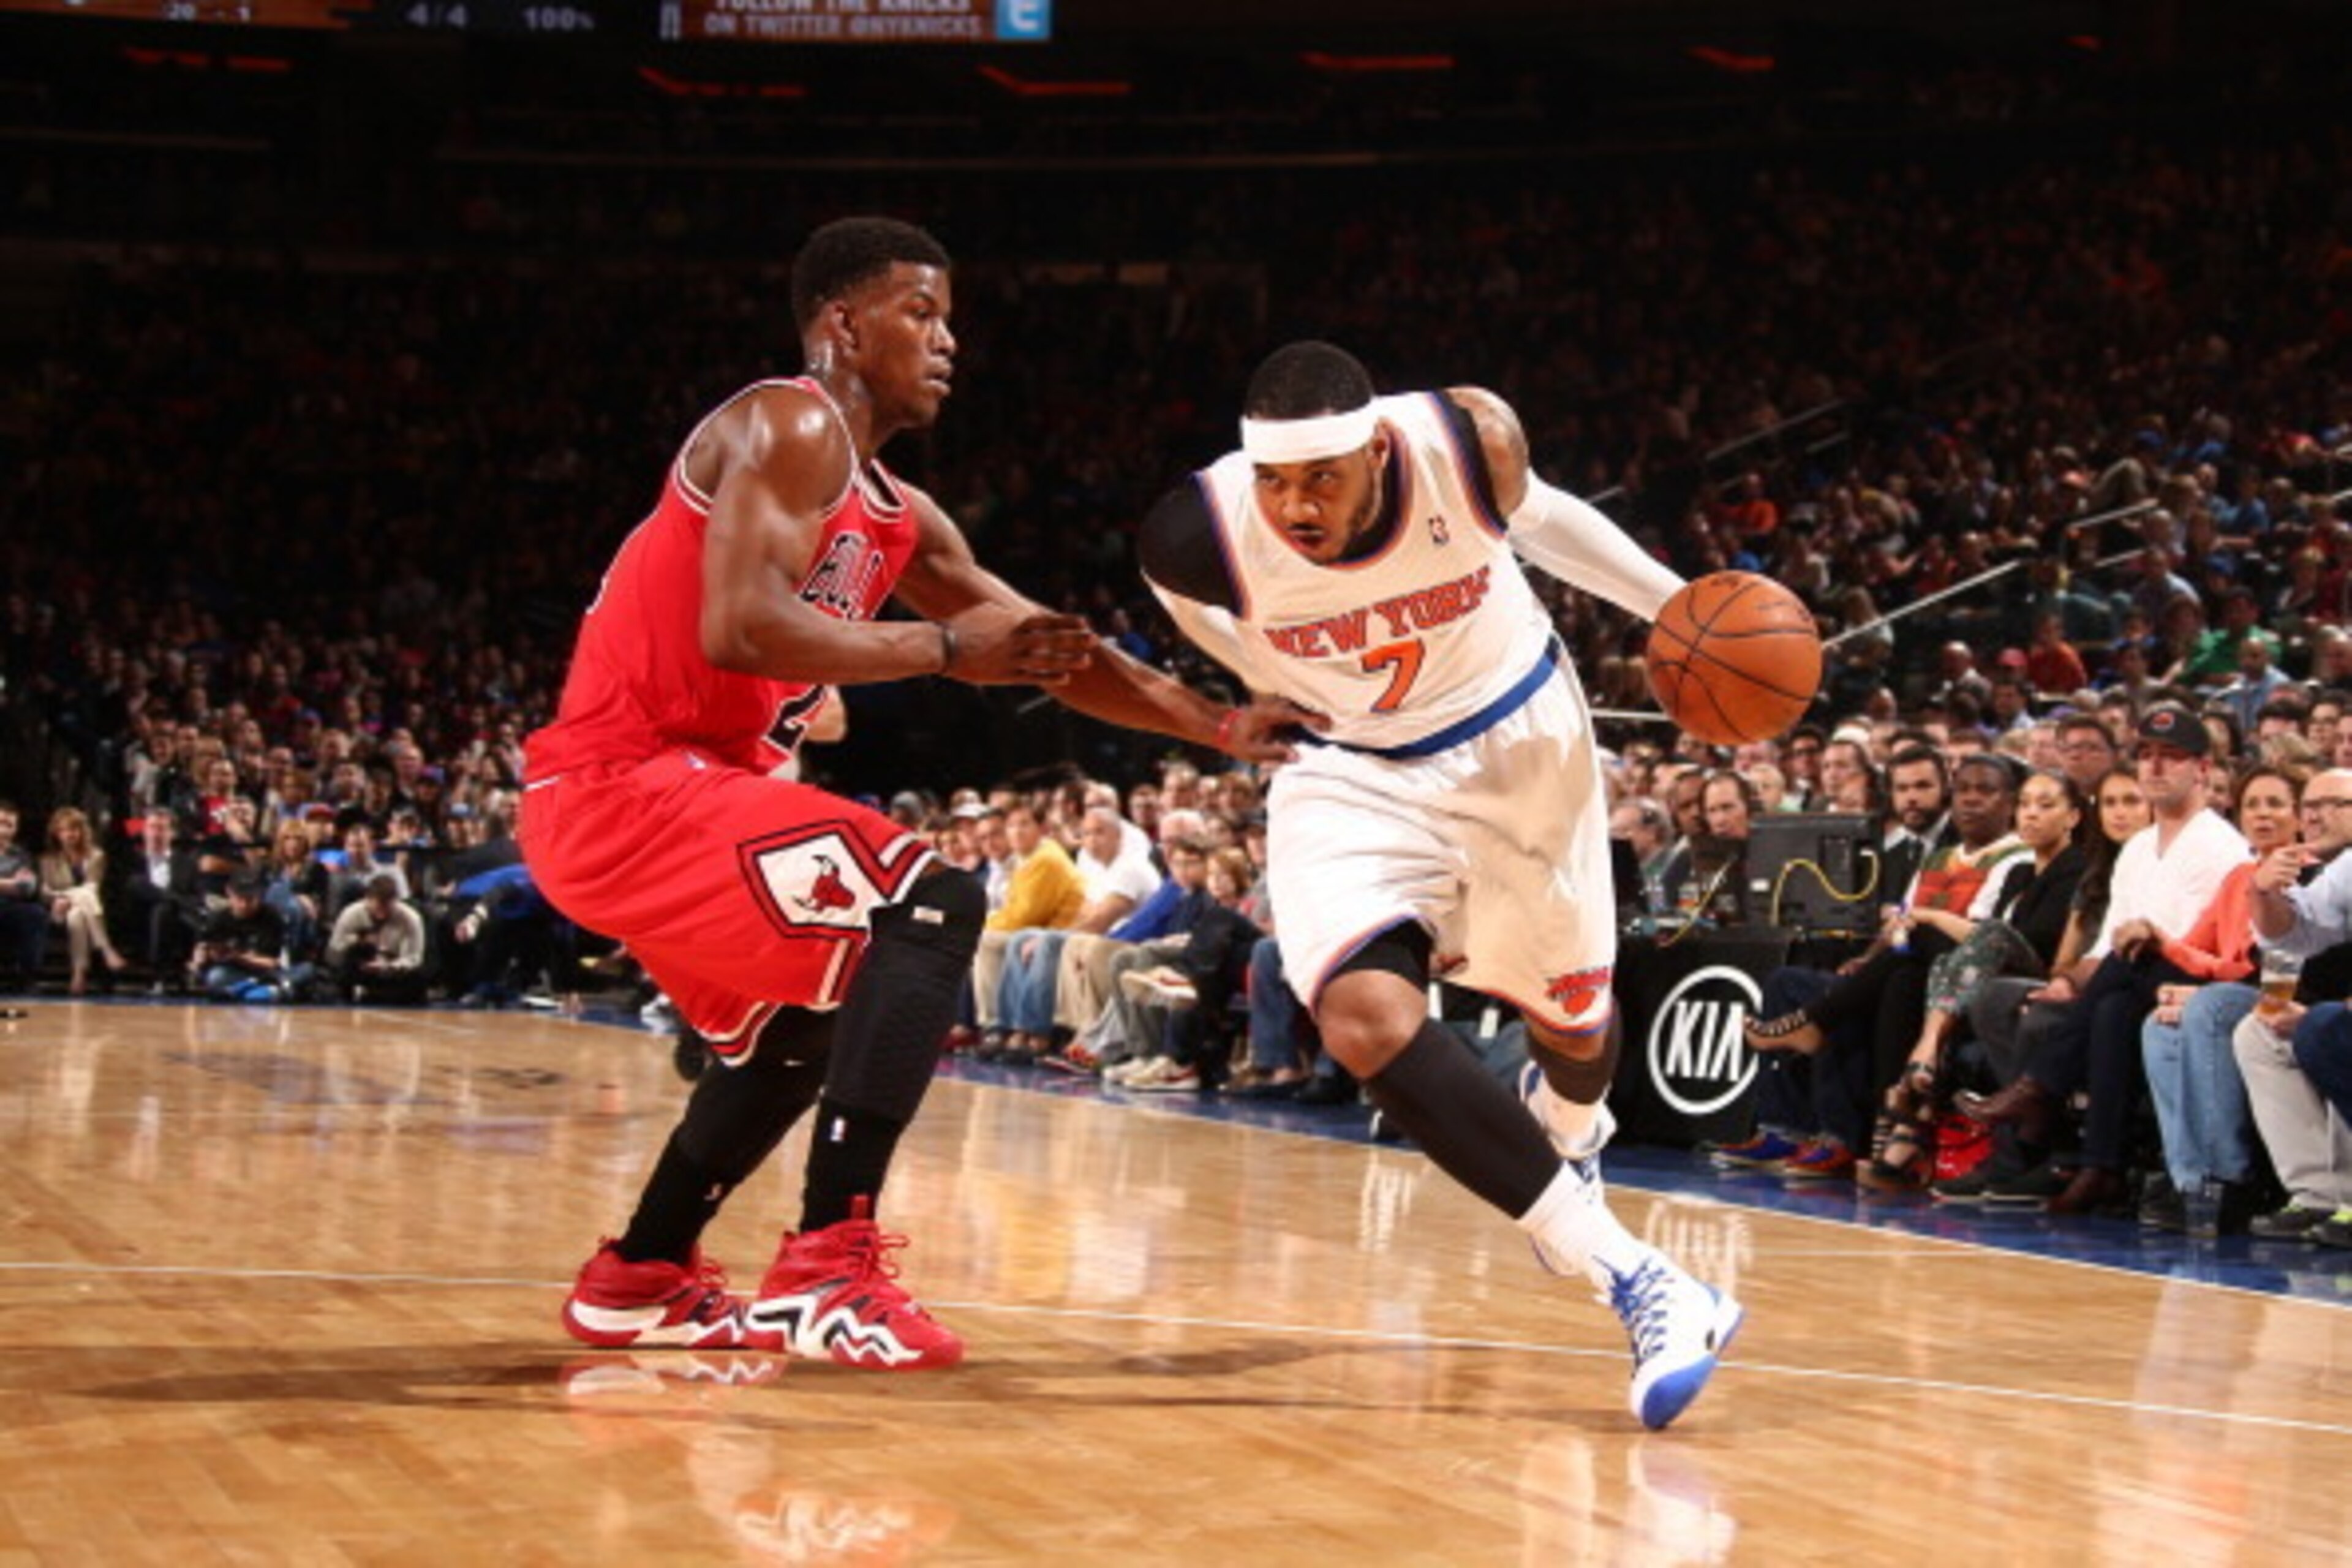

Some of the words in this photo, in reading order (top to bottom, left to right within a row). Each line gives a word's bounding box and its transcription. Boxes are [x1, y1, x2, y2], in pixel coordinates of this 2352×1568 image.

[1263, 608, 1370, 658] NEW
[1373, 562, 1490, 638] YORK
[1360, 637, 1426, 713] 7
[1665, 1000, 1744, 1082] KIA
